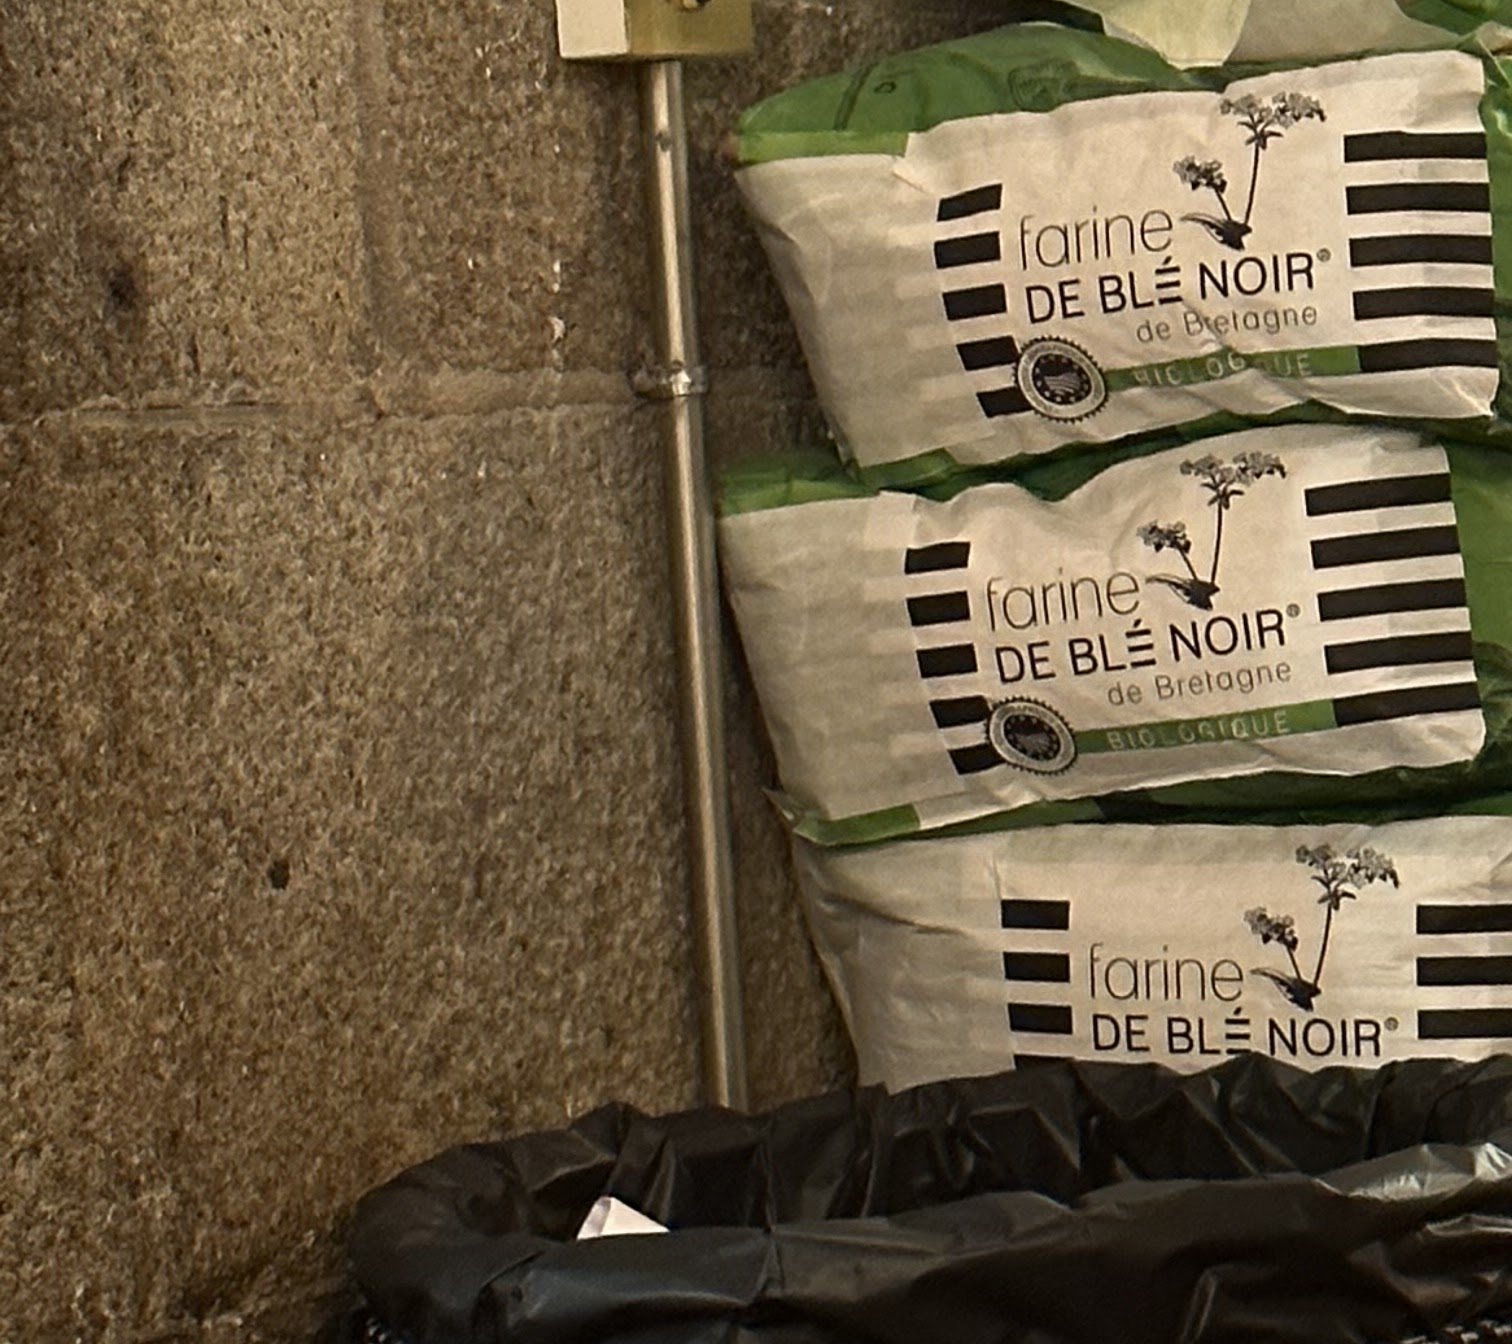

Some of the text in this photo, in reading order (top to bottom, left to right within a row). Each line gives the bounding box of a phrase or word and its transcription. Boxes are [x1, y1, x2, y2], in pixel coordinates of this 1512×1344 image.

[1020, 206, 1172, 270] farine
[1025, 279, 1084, 324] DE
[1099, 256, 1182, 313] BLÉ
[1136, 306, 1317, 343] de Bretagne
[987, 567, 1139, 632] farine
[995, 641, 1055, 684] DE
[1068, 619, 1156, 675] BLÉ
[1108, 661, 1291, 706] de Bretagne
[1106, 710, 1290, 749] BIOLOGIQUE
[1090, 943, 1243, 1002] farine
[1093, 1013, 1150, 1052] DE
[1167, 1007, 1250, 1054] BLÉ
